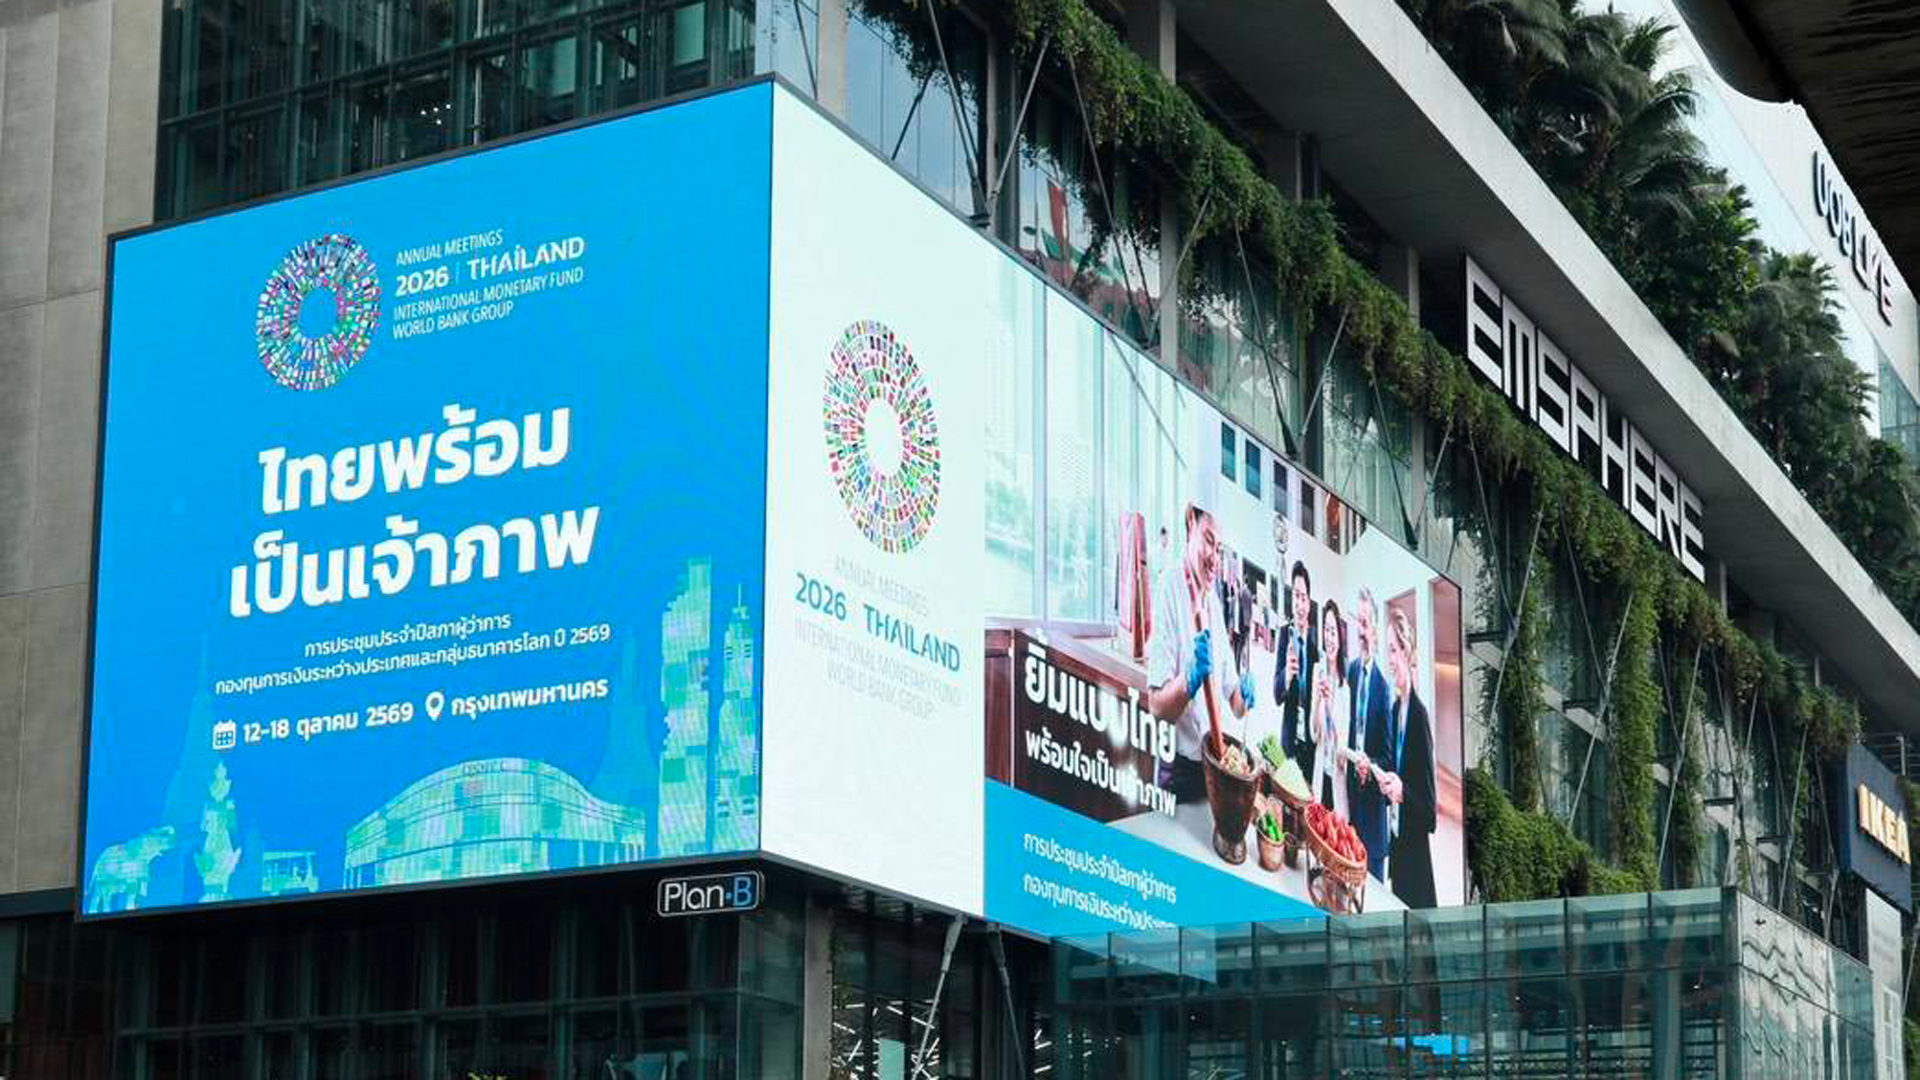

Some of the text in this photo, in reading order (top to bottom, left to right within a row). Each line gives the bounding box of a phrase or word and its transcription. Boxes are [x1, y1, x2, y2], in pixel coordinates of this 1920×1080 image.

[396, 229, 503, 266] ANNUAL MEETINGS
[394, 267, 584, 321] INTERNATIONAL MONETARY FUND
[395, 266, 449, 297] 2026
[393, 301, 514, 339] WORLD BANK GROUP
[1466, 254, 1705, 584] EMSPHERE
[258, 403, 570, 515] ไทยพร้อม
[229, 506, 600, 618] เป็นเจ้าภาพ
[795, 571, 847, 621] 2026
[215, 624, 610, 694] กองทุนการเงินระหว่างประเทศและกลุ่มธนาคารโลก ปี 2569
[305, 614, 511, 658] การประชุมประจำปีสภาผู้ว่าการ
[244, 701, 414, 743] 12-18 ตุลาคม 2569
[451, 678, 609, 720] กรุงเทพมหานคร
[1858, 783, 1911, 865] IKEA
